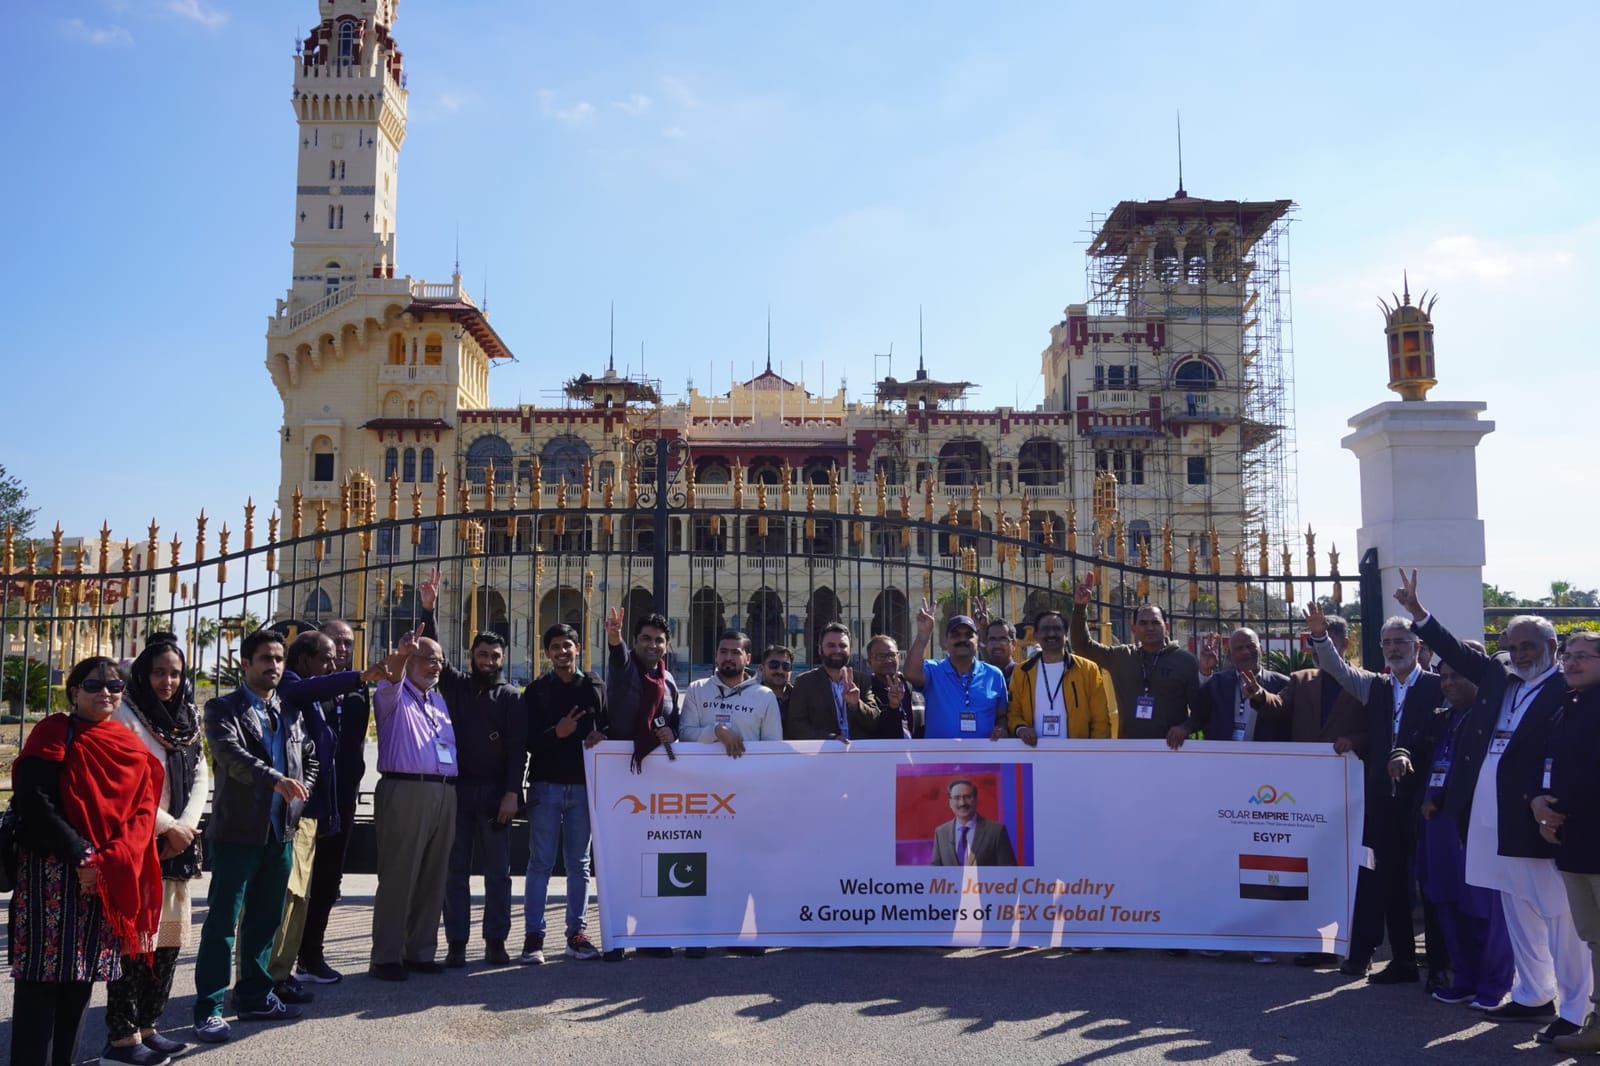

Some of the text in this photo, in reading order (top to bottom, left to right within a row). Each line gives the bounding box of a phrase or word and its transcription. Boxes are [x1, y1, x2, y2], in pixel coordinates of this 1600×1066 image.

[703, 702, 754, 713] GIVENCHY
[650, 793, 737, 815] IBEX
[1218, 809, 1328, 824] SOLAR EMPIRE TRAVEL
[647, 830, 702, 840] PAKISTAN
[1253, 832, 1292, 844] EGYPT
[840, 877, 1115, 899] Welcome Mr. Javed Chaudhry
[800, 904, 1161, 925] & Group Members of IBEX Global Tours
